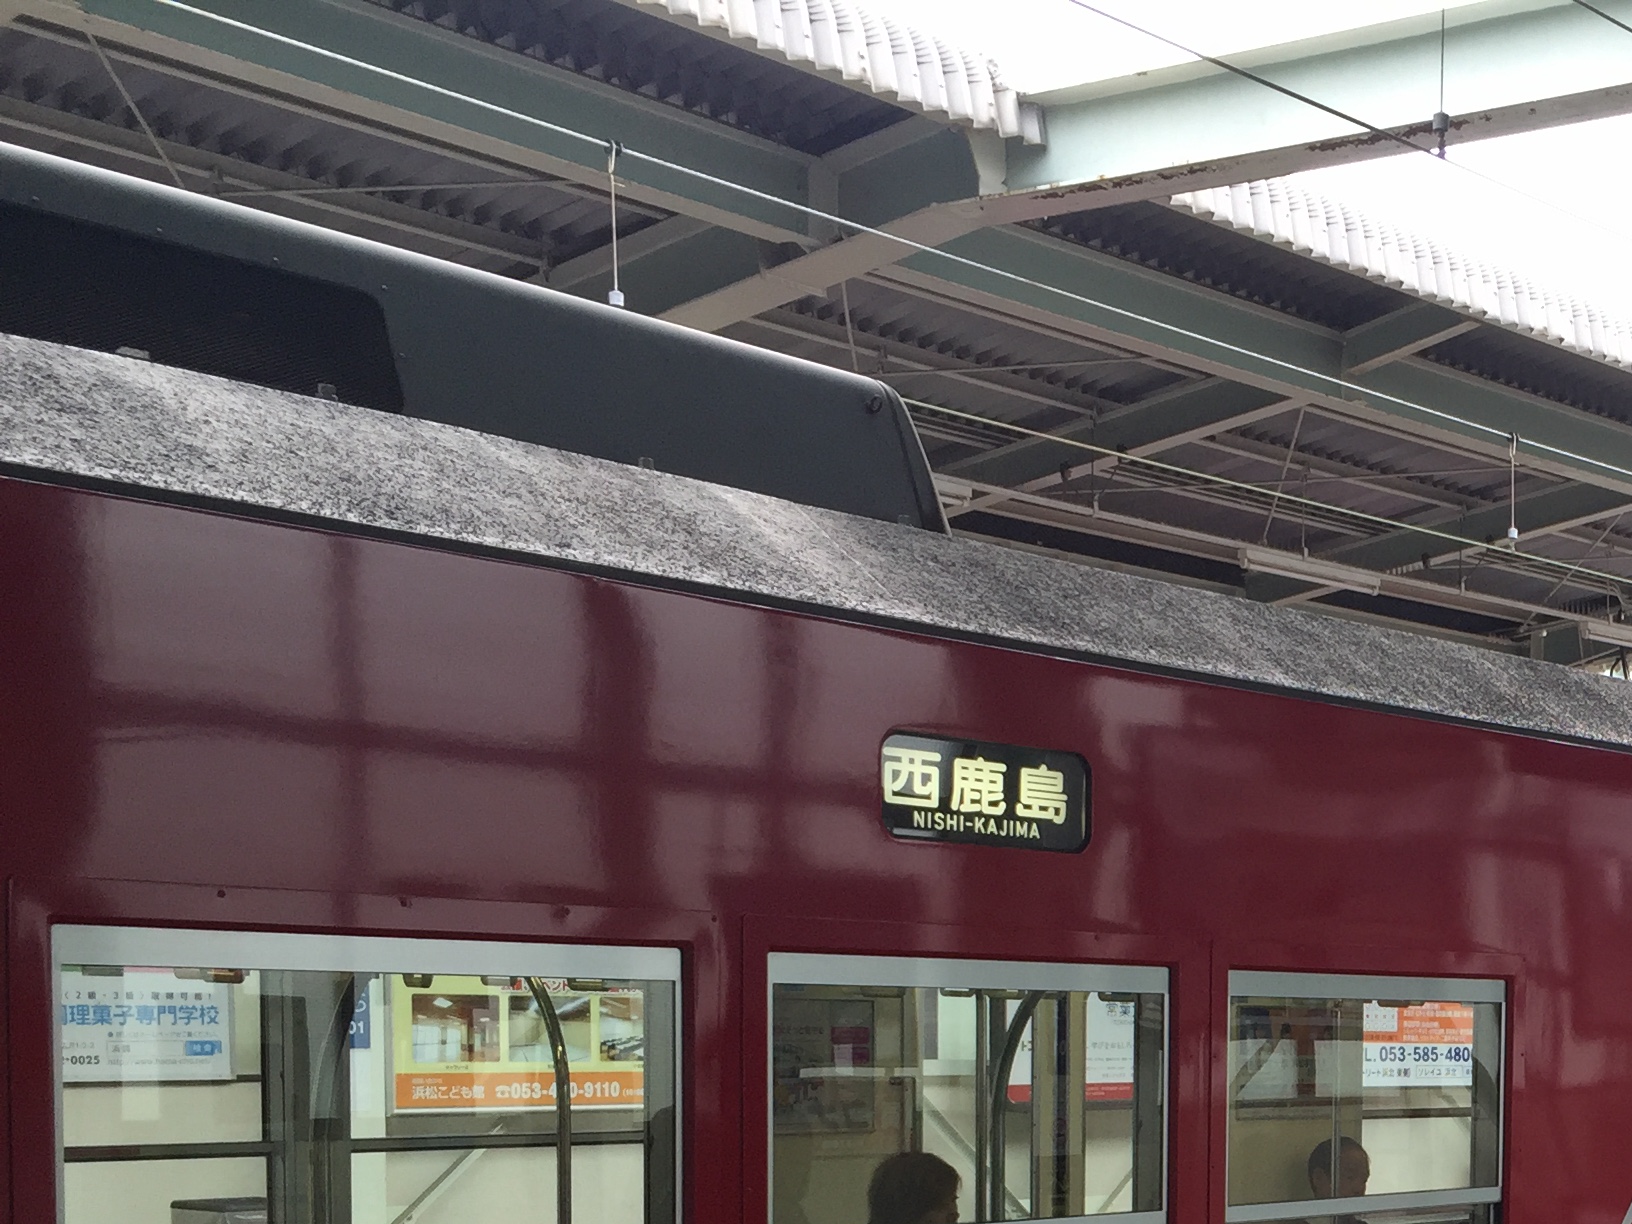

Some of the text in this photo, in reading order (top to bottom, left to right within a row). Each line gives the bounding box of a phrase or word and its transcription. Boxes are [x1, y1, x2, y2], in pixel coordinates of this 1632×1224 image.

[881, 746, 1068, 825] 西鹿島
[913, 810, 1041, 839] NISHI-KAJIMA
[411, 1084, 485, 1099] 浜松こども館
[510, 1081, 620, 1099] 053-40-9110
